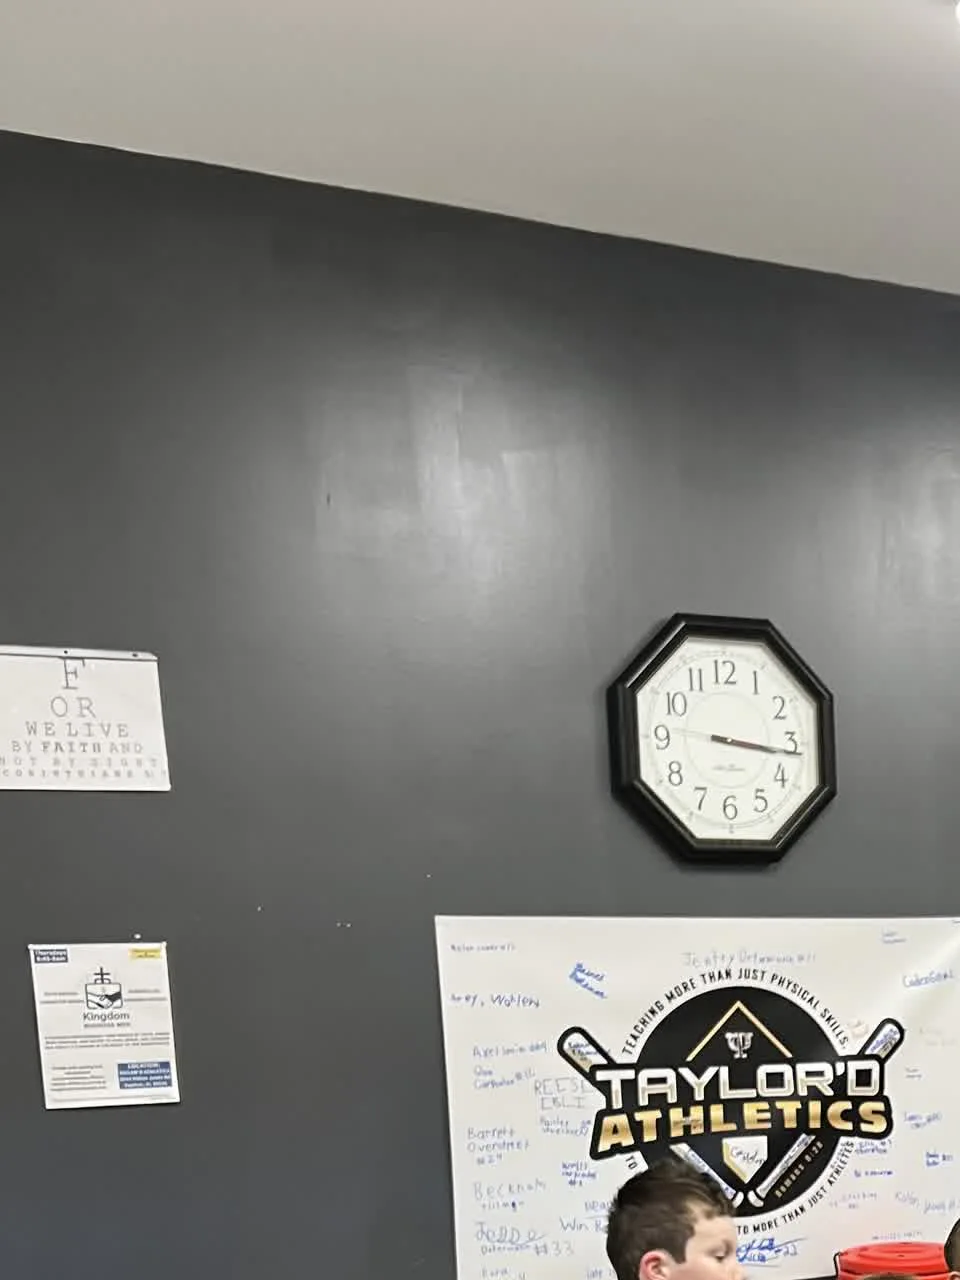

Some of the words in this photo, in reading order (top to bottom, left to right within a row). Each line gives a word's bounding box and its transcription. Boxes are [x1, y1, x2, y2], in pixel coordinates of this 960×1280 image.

[688, 667, 704, 692] 11
[713, 660, 737, 686] 12
[752, 671, 760, 695] 1
[666, 692, 688, 717] 10
[772, 696, 787, 720] 2
[67, 722, 130, 738] LIVE
[654, 725, 671, 750] 9
[784, 731, 798, 753] 3
[42, 742, 102, 753] FAITH
[668, 761, 684, 787] 8
[774, 763, 788, 788] 4
[694, 787, 708, 811] 7
[722, 795, 738, 820] 6
[754, 789, 769, 813] 5
[83, 1011, 130, 1022] Kingdom
[621, 1000, 666, 1056] TEACHING
[664, 977, 697, 1003] MORE
[699, 968, 732, 985] THAN
[738, 968, 767, 980] JUST
[769, 973, 821, 1009] PHYSICAL
[596, 1059, 881, 1111] TAYLOR'D
[597, 1099, 888, 1153] ATHLETICS
[625, 1155, 639, 1170] TO
[752, 1220, 779, 1234] MORE
[781, 1206, 807, 1224] THAN
[807, 1185, 829, 1209] JUST
